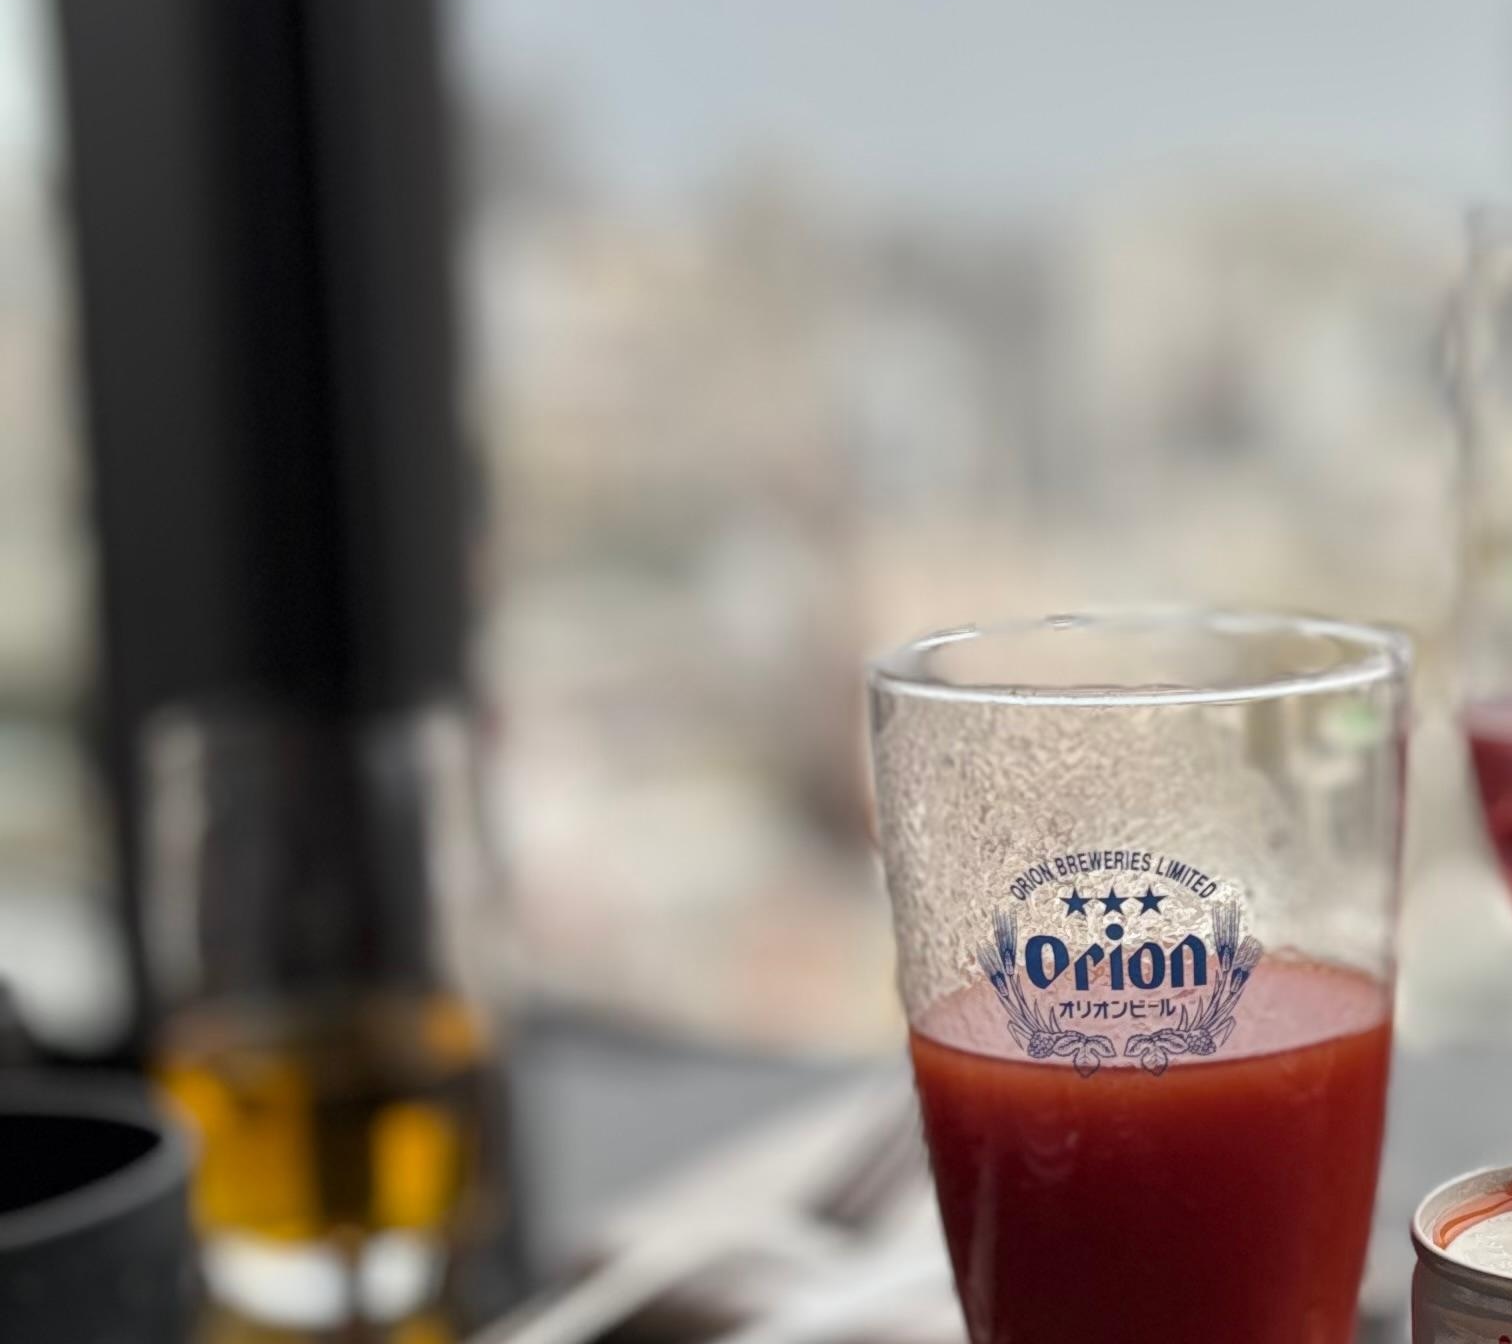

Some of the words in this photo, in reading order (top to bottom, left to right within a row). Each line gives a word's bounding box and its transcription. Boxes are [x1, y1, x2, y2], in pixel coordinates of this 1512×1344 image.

[1009, 860, 1056, 902] ORION
[1054, 850, 1151, 877] BREWERIES
[1155, 856, 1217, 899] LIMITED
[1059, 999, 1176, 1019] オリオンビール
